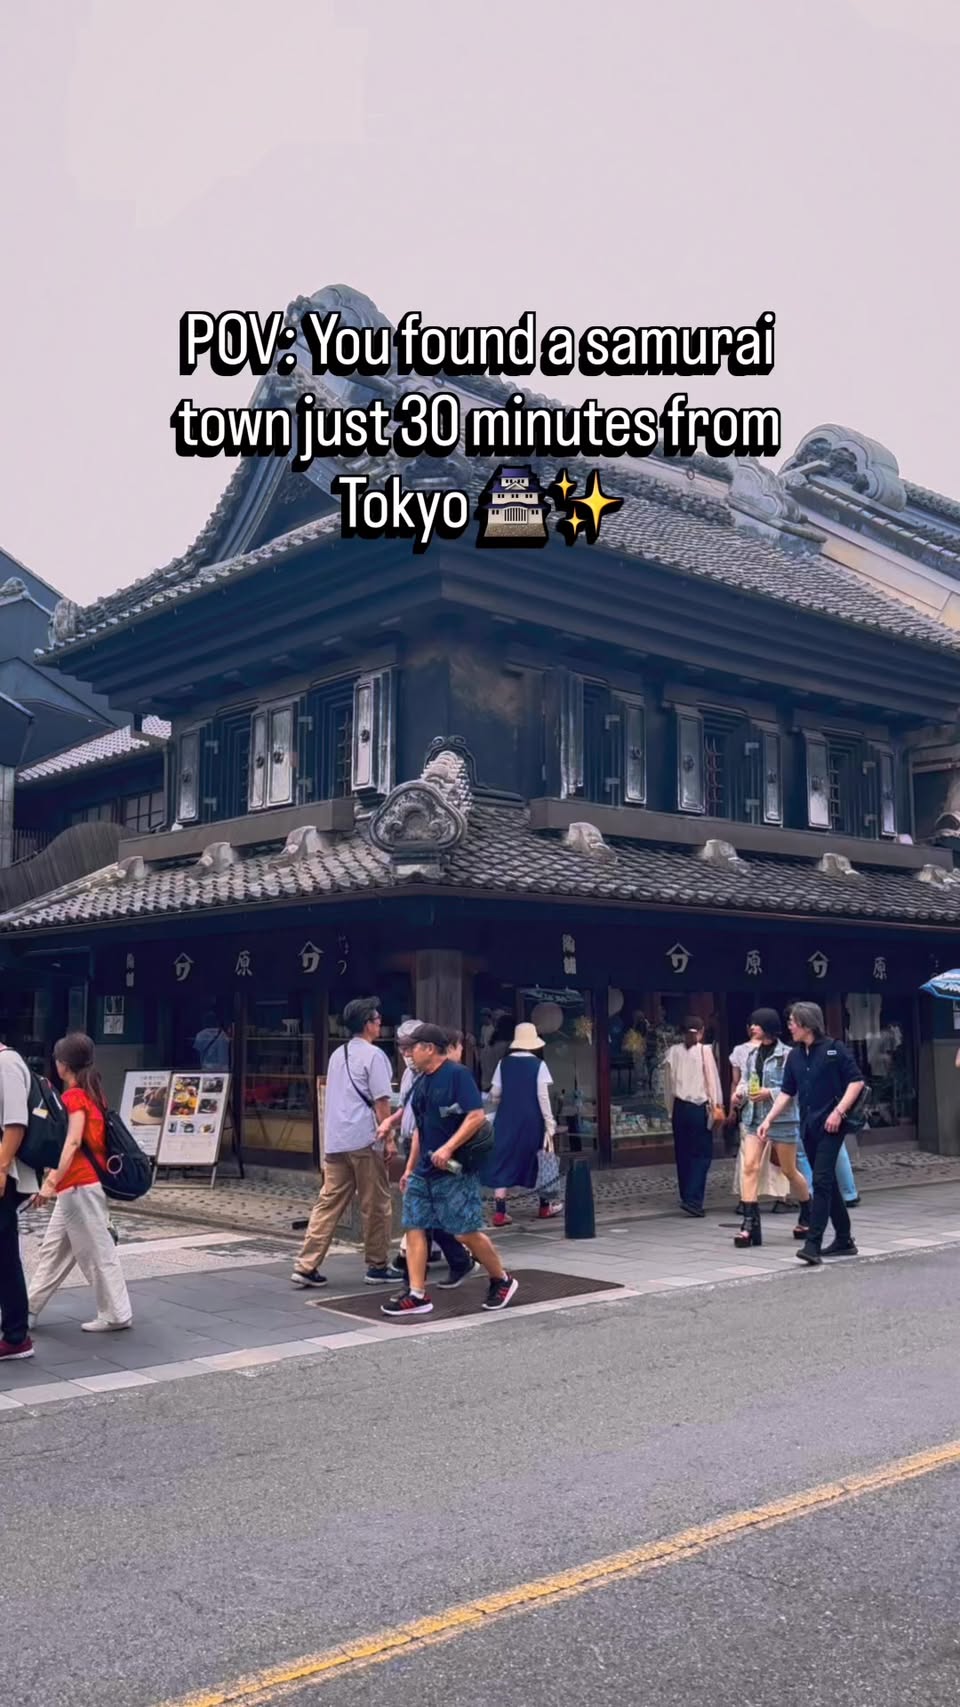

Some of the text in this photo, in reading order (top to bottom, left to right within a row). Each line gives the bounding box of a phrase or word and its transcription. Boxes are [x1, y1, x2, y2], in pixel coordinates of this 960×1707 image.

[235, 950, 253, 976] 原
[745, 949, 763, 975] 原
[872, 956, 888, 980] 原
